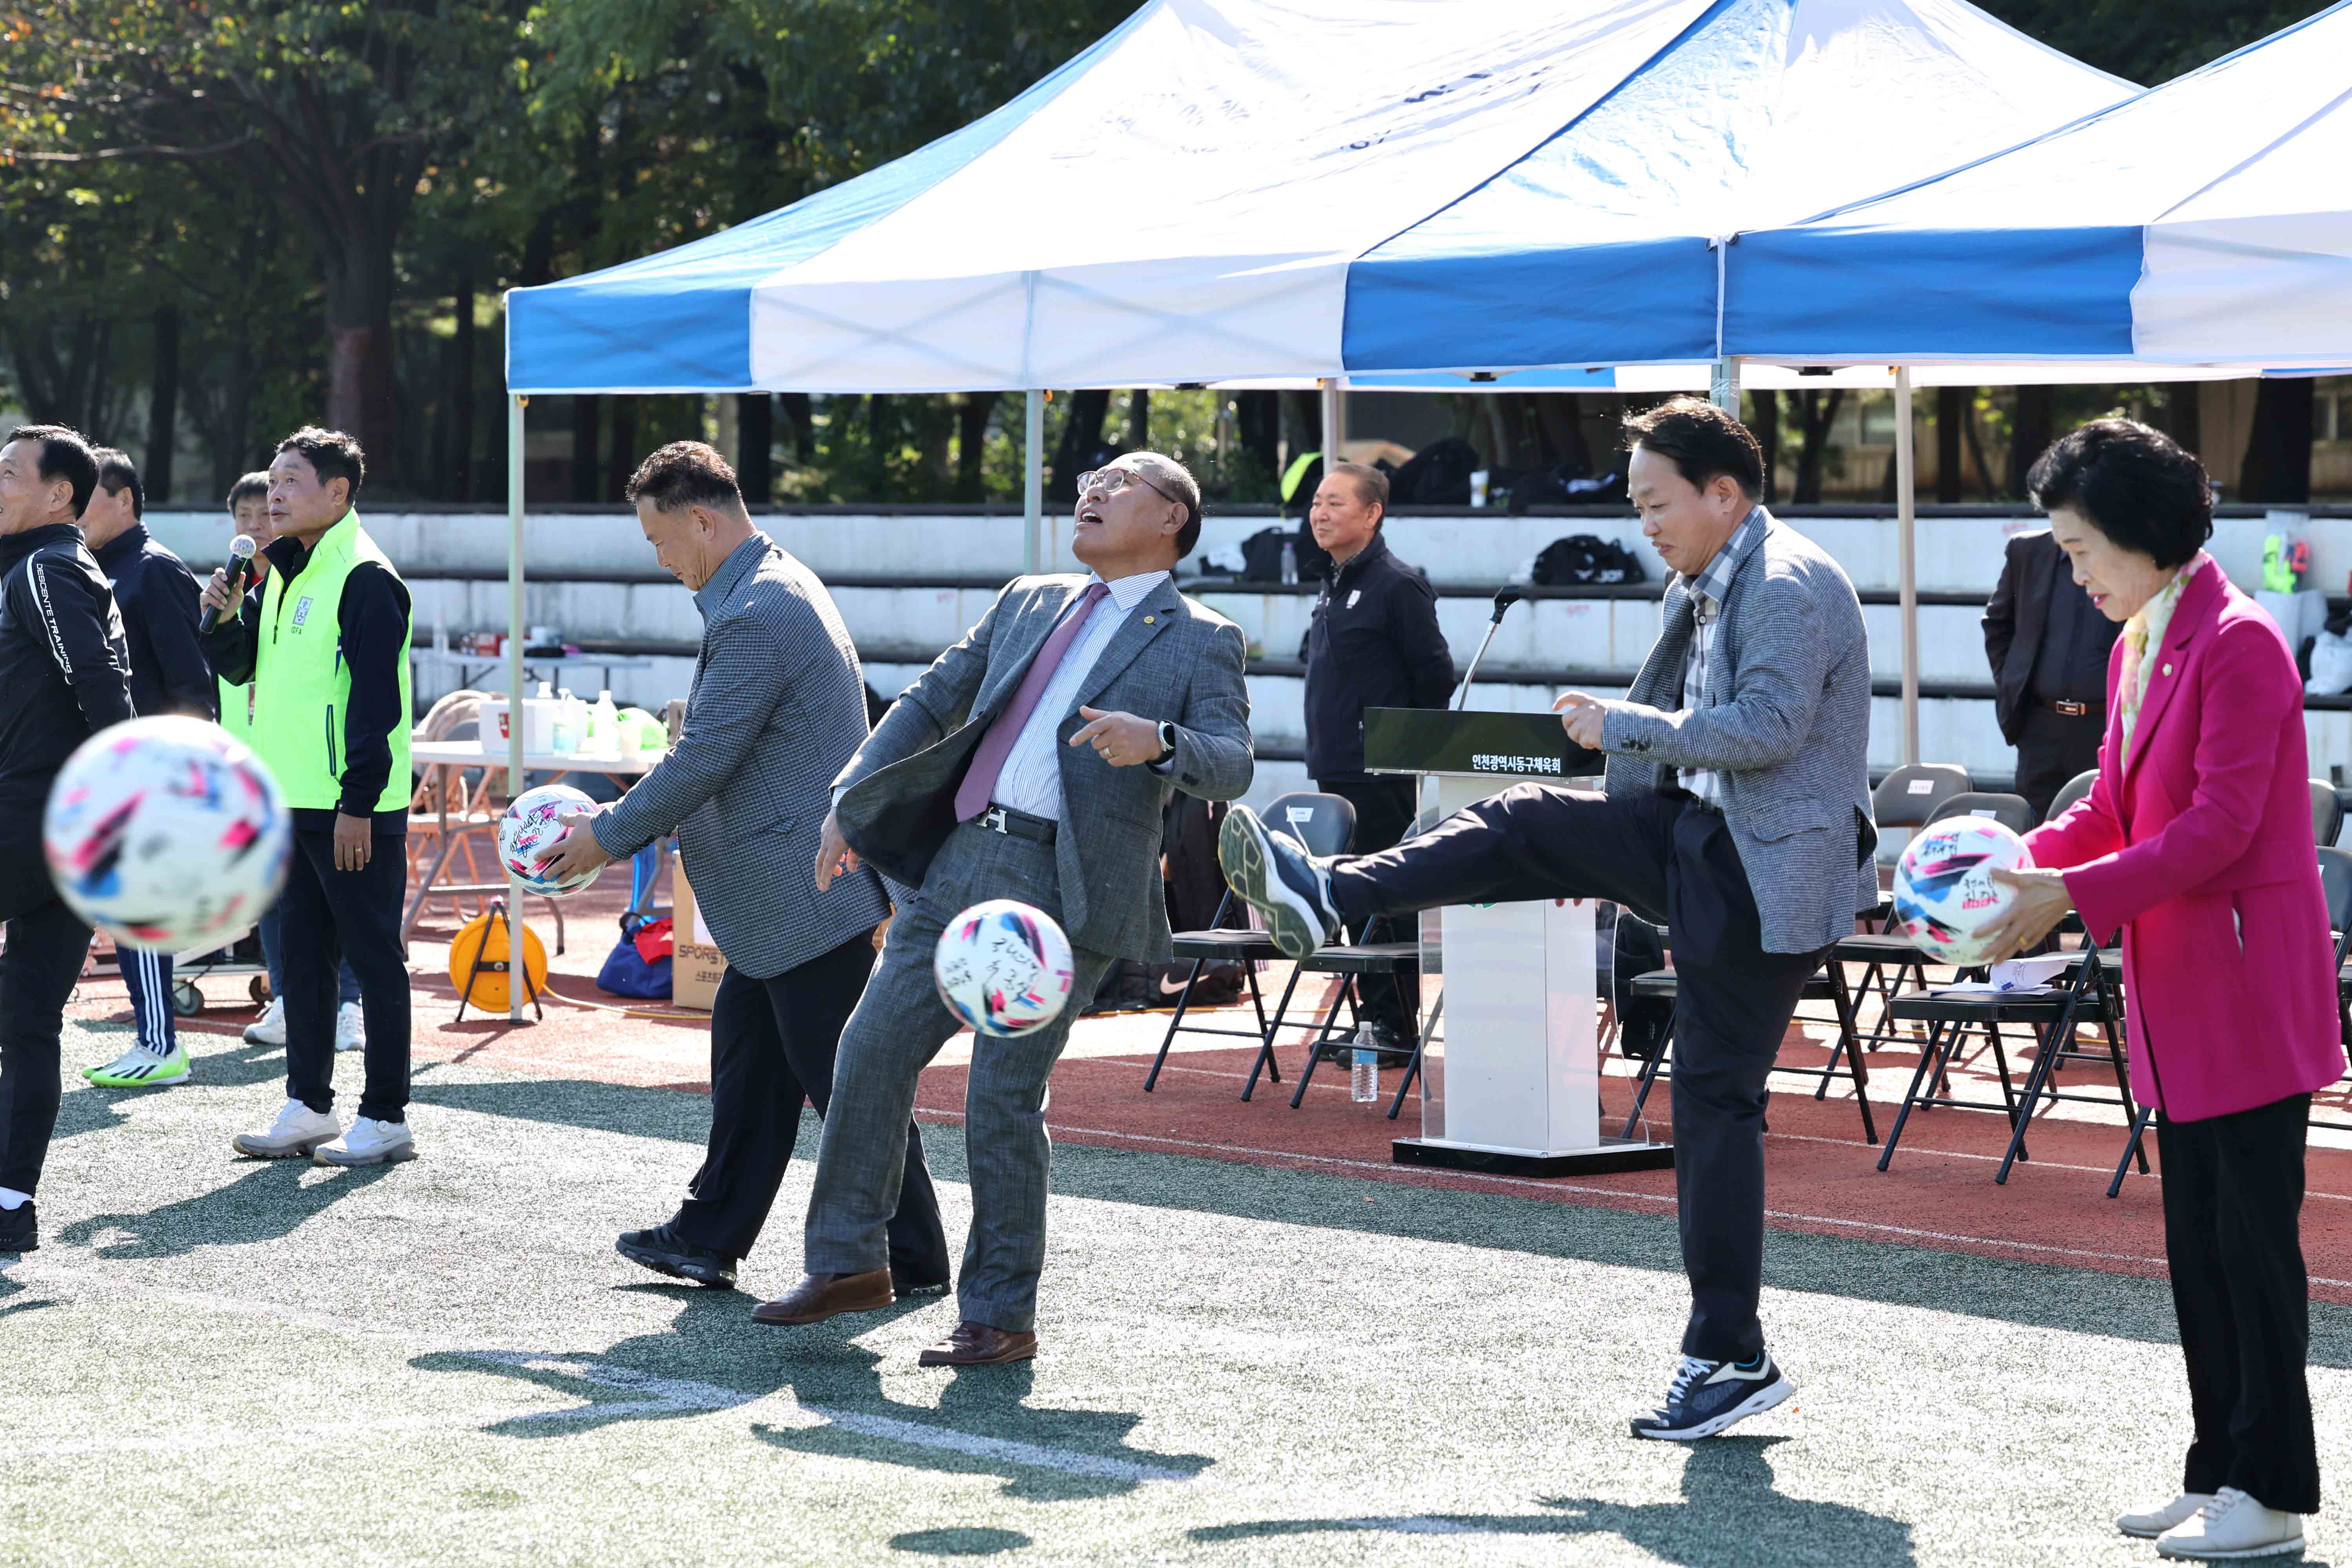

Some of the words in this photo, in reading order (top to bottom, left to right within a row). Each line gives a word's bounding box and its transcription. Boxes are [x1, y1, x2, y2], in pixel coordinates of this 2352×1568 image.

[36, 563, 54, 617] DESCENTE
[49, 618, 73, 673] TRAINING
[1472, 754, 1561, 773] 인천광역시동구체육회
